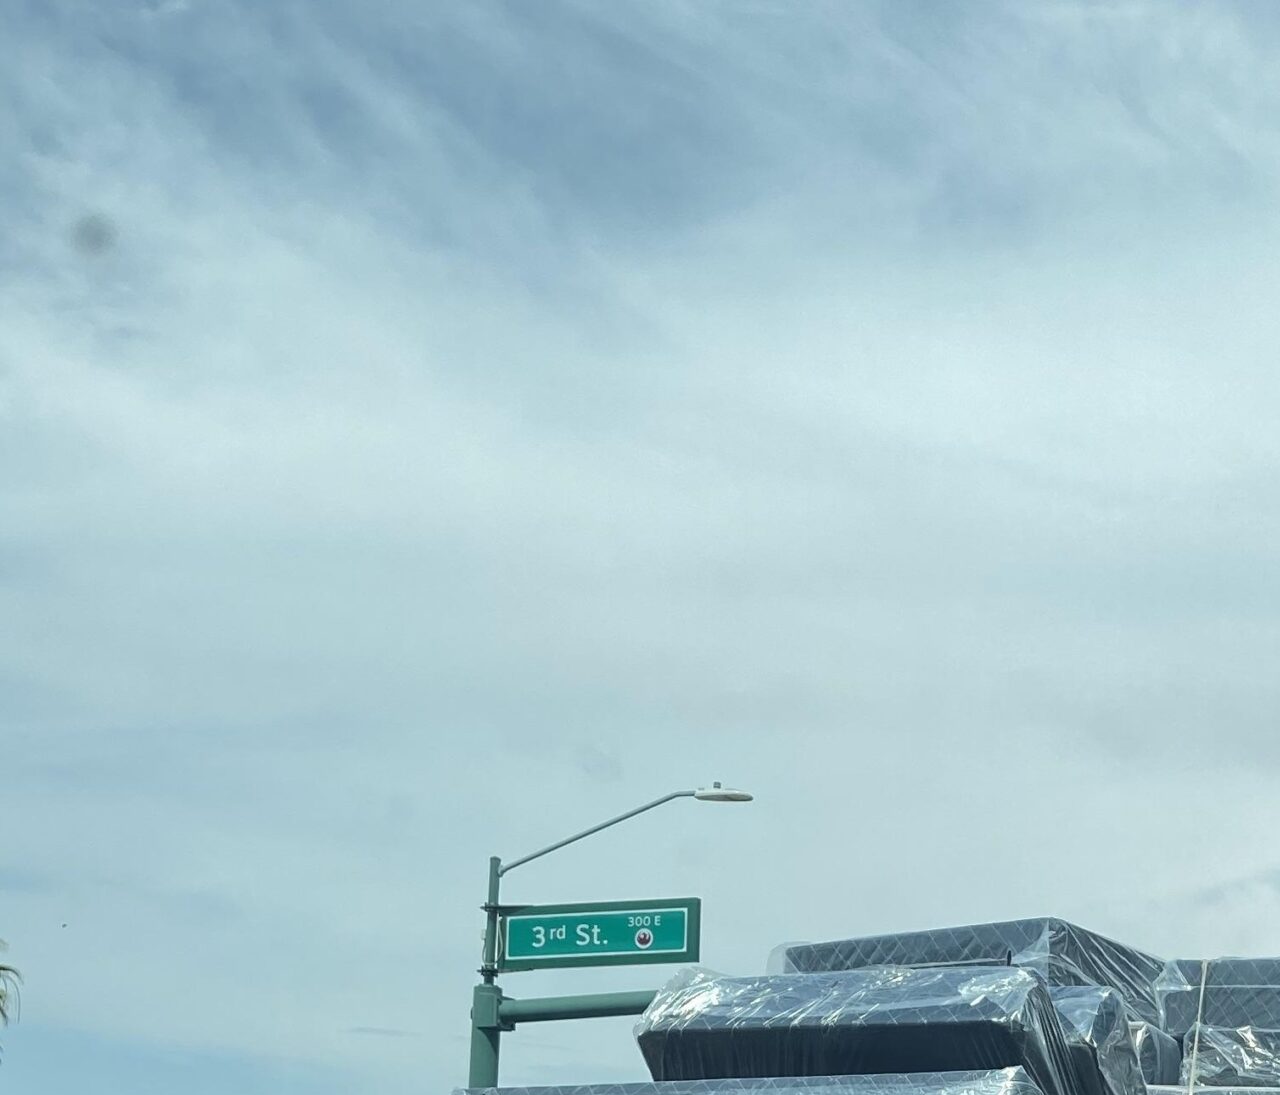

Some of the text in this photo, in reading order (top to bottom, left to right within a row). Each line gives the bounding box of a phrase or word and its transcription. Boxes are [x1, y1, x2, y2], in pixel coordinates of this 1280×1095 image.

[627, 915, 661, 927] 300 E
[531, 923, 609, 948] 3rd St.
